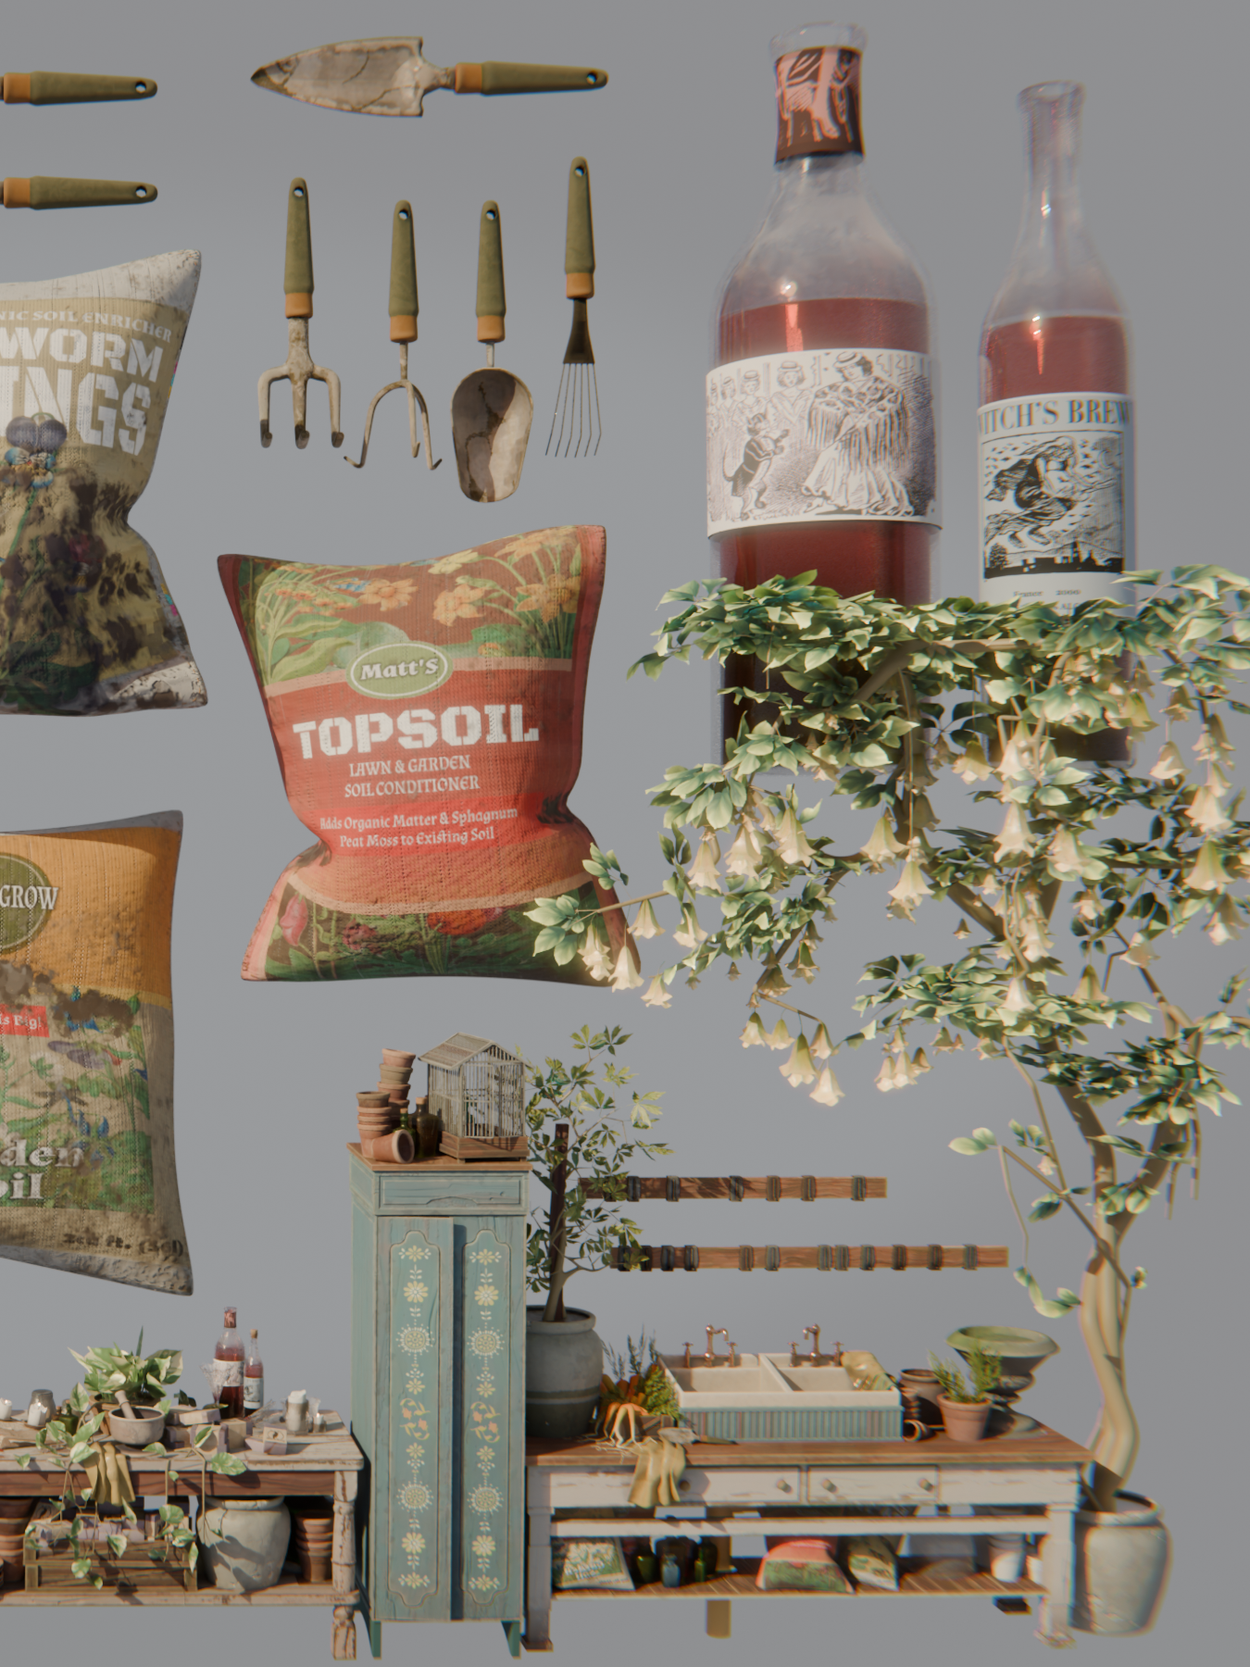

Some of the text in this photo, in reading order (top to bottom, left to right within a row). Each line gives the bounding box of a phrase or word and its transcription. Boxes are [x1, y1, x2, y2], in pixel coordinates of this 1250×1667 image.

[32, 310, 79, 323] SOIL
[292, 703, 540, 760] TOPSOIL
[349, 754, 471, 778] LAWN & GARDEN
[344, 774, 480, 798] SOIL CONDITIONER
[343, 811, 391, 832] Organic
[392, 808, 437, 828] Matter
[439, 808, 450, 825] &
[451, 806, 519, 827] Sphagnum
[339, 825, 496, 848] Peat Moss to Existing Soil
